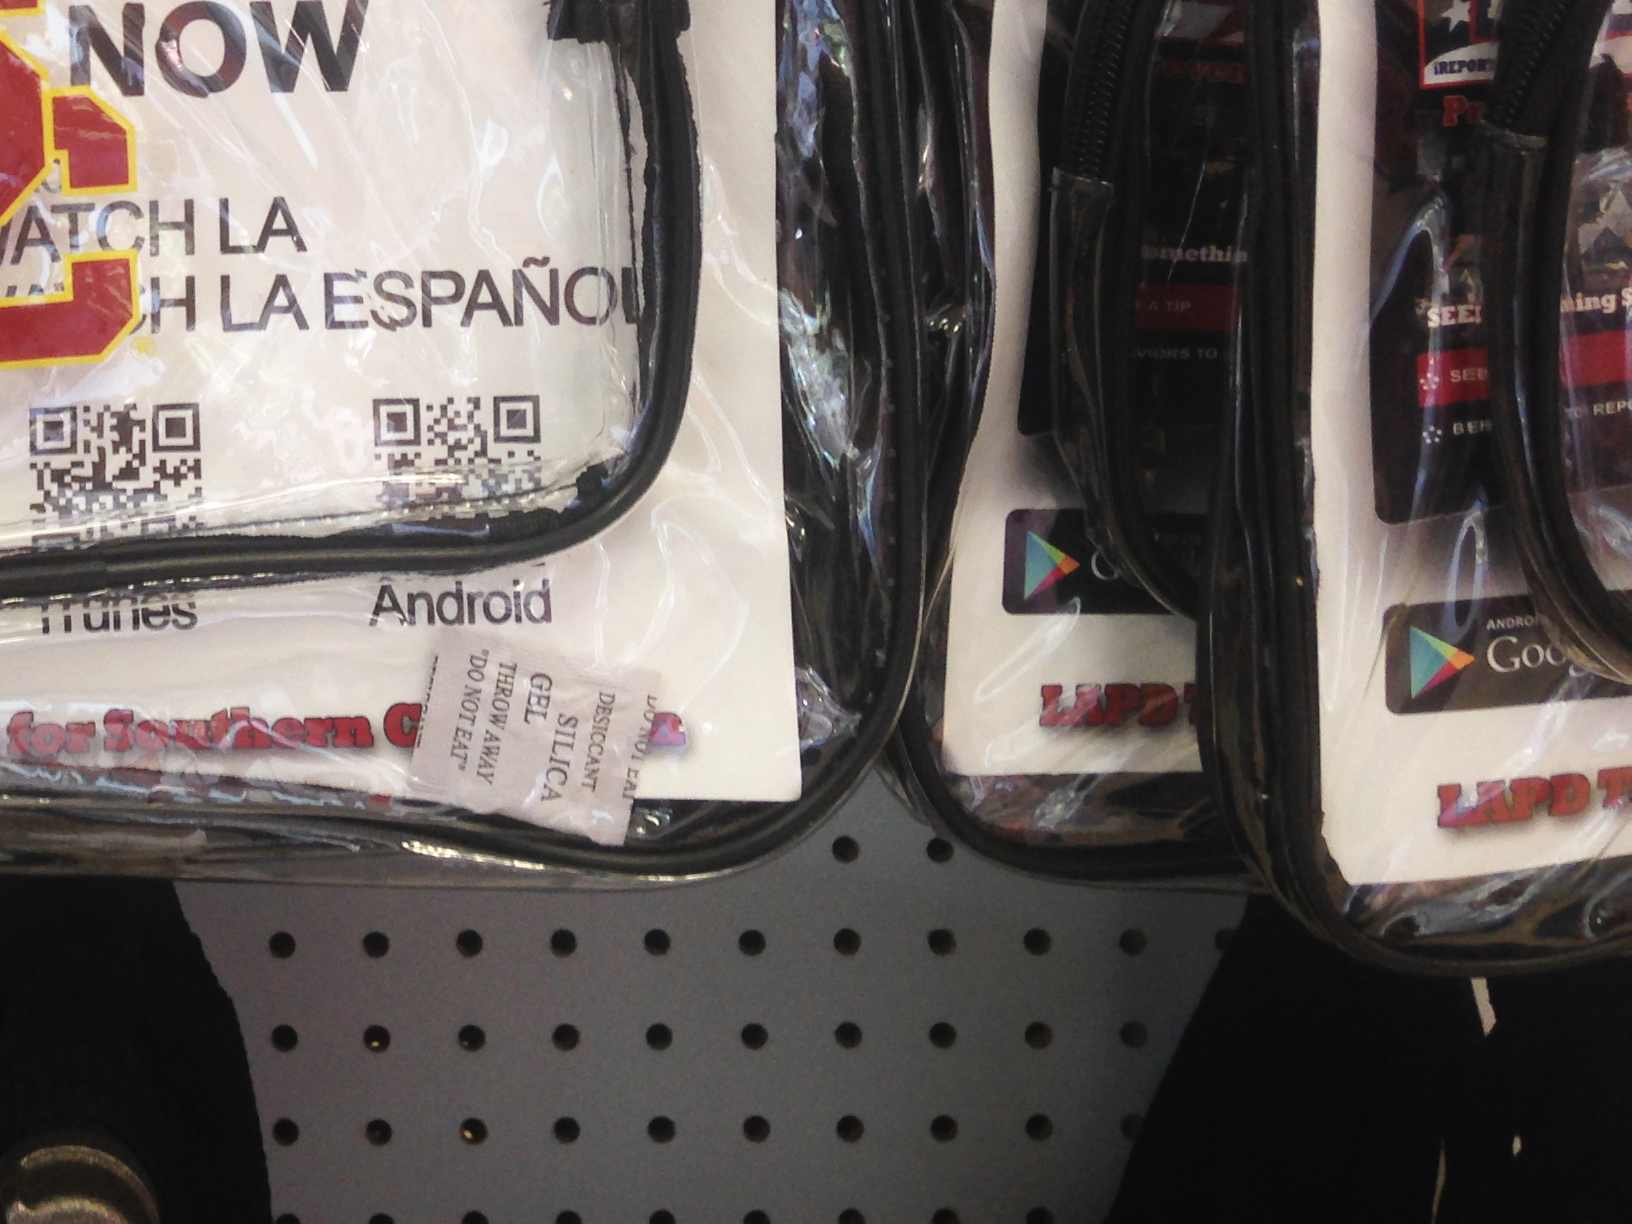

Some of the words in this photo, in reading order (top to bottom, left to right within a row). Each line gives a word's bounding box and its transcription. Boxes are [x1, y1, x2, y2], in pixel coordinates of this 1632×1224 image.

[219, 196, 307, 257] LA
[219, 273, 309, 333] LA
[368, 578, 553, 628] Android
[458, 684, 483, 724] NOT
[489, 661, 518, 727] THROW
[523, 672, 554, 726] GEL
[1039, 683, 1178, 728] LAPD
[5, 711, 96, 761] for
[102, 706, 374, 755] Southern
[475, 728, 502, 786] AWAY
[540, 713, 579, 802] SILICA
[580, 689, 616, 793] DESICCANT
[1437, 772, 1592, 829] LAPD
